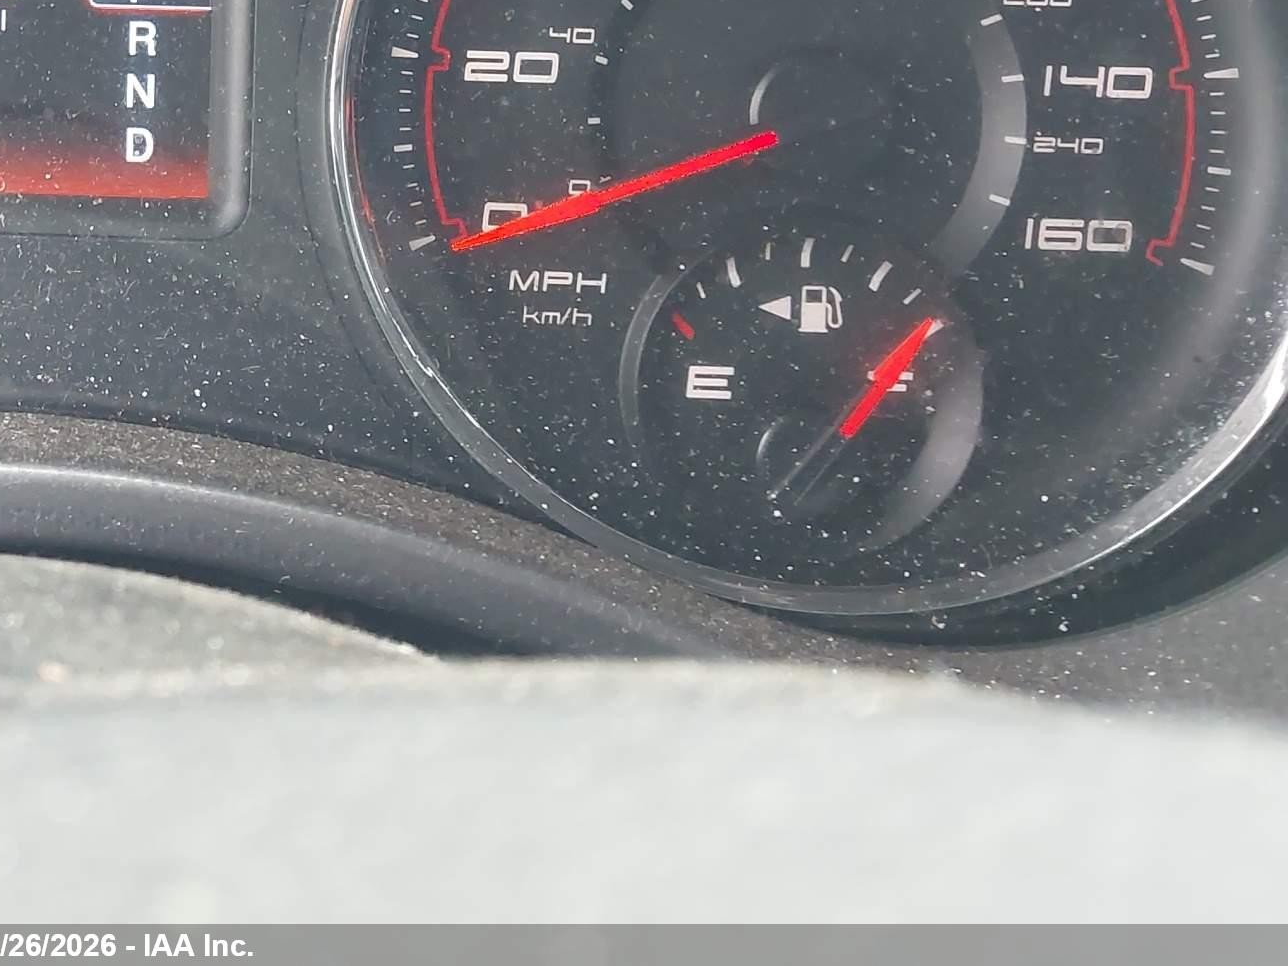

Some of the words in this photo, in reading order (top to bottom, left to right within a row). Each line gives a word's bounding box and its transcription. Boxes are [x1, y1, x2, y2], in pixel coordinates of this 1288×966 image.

[129, 21, 157, 56] R
[549, 27, 595, 45] 40
[464, 50, 559, 84] 20
[1045, 66, 1154, 100] 140
[126, 74, 155, 108] N
[126, 127, 154, 162] D
[1033, 136, 1104, 155] 240
[482, 203, 528, 234] 0
[1025, 219, 1133, 253] 160
[508, 270, 607, 294] MPH
[522, 305, 592, 327] km/h
[686, 365, 735, 400] E
